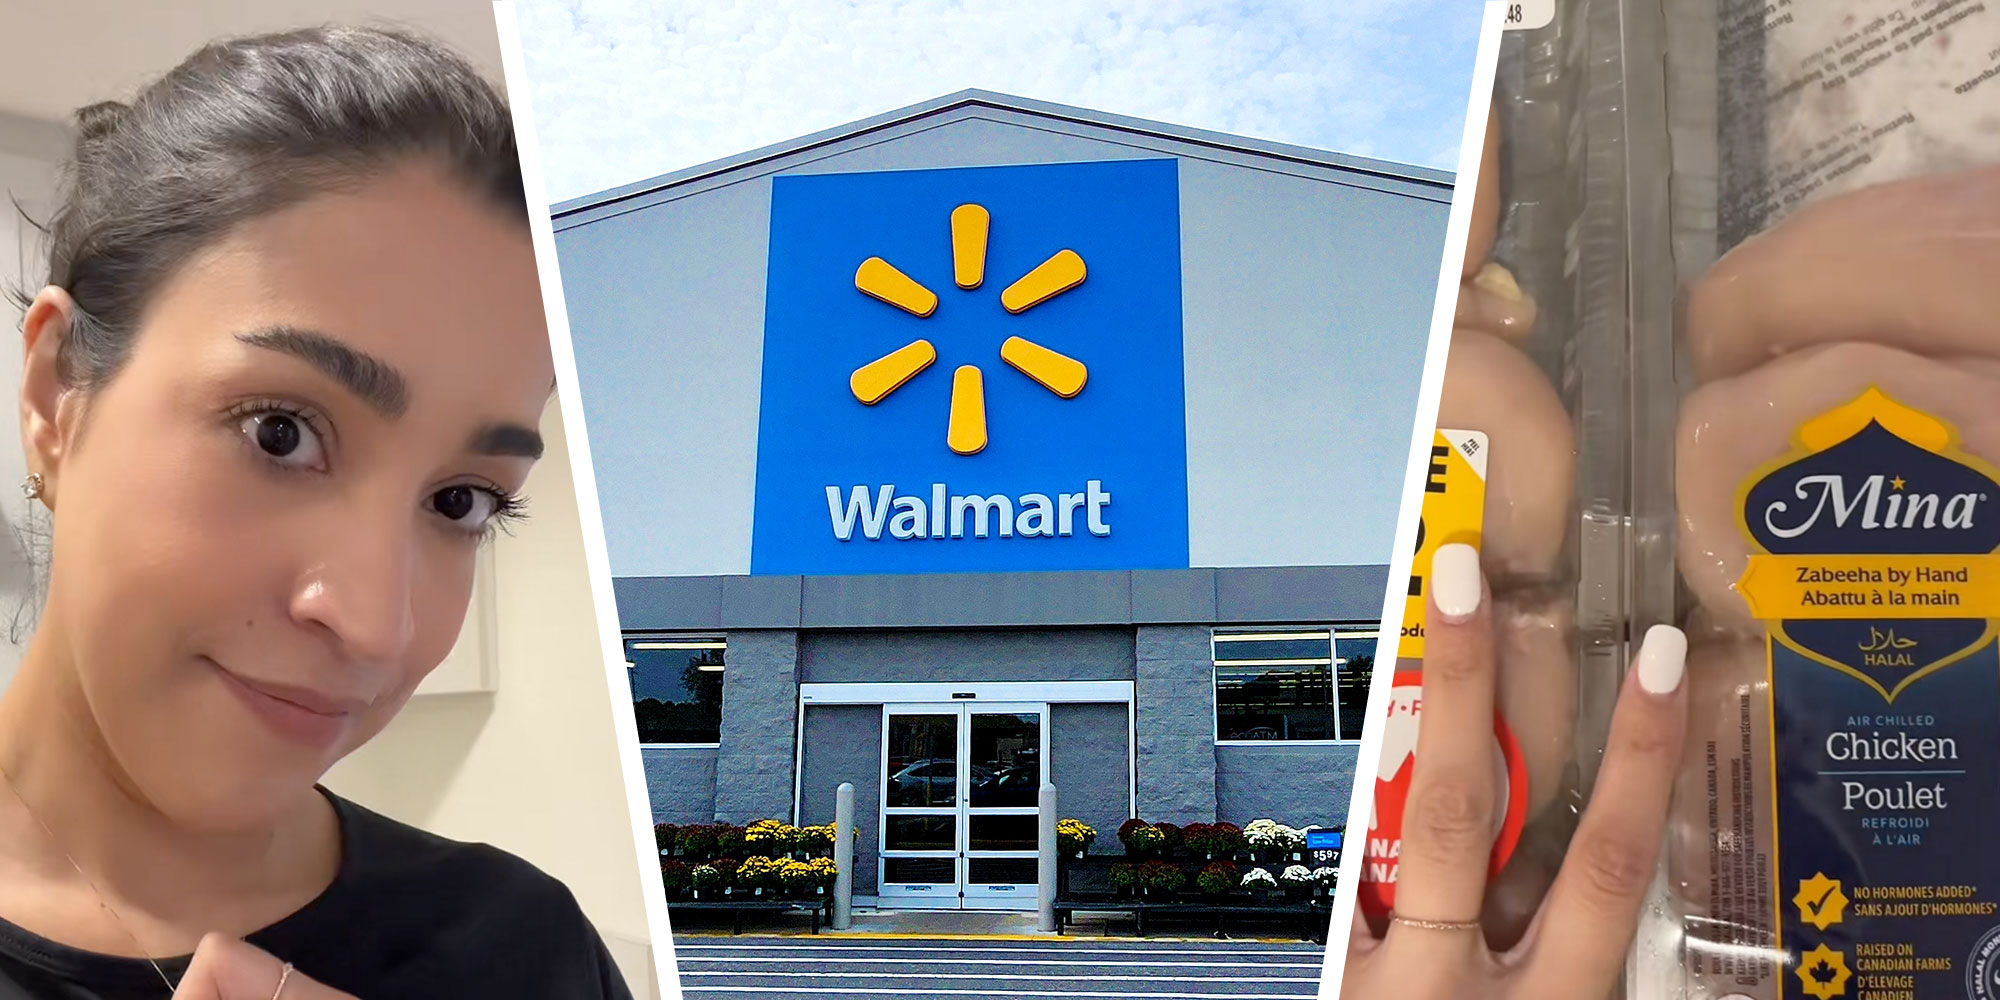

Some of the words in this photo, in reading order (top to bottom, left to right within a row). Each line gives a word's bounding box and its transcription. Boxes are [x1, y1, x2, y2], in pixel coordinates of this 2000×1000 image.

[1936, 2, 1985, 31] Remove
[825, 479, 1111, 541] Walmart
[1765, 475, 1978, 538] Mina
[1796, 567, 1882, 583] Zabeeha
[1888, 567, 1911, 586] by
[1916, 567, 1968, 583] Hand
[1801, 590, 1866, 606] Abattu
[1872, 589, 1883, 606] à
[1889, 590, 1906, 606] la
[1911, 590, 1960, 606] main
[1858, 626, 1918, 651] حلال
[1864, 654, 1915, 666] HALAL
[1847, 715, 1871, 726] AIR
[1875, 715, 1935, 726] CHILLED
[1826, 731, 1958, 762] Chicken
[1842, 781, 1948, 810] Poulet
[1862, 817, 1930, 828] REFROIDI
[1872, 832, 1882, 845] À
[1886, 834, 1921, 845] L'AIR
[1853, 887, 1870, 899] NO
[1872, 886, 1934, 899] HORMONES
[1854, 904, 1883, 916] SANS
[1884, 903, 1919, 916] AJOUT
[1856, 944, 1895, 956] RAISED
[1896, 943, 1914, 956] ON
[1856, 958, 1913, 972] CANADIAN
[1915, 957, 1952, 970] FARMS
[1857, 973, 1914, 988] D'ÉLEVAGE
[1974, 958, 1986, 994] HALAL
[1857, 990, 1914, 1000] CANADIEN
